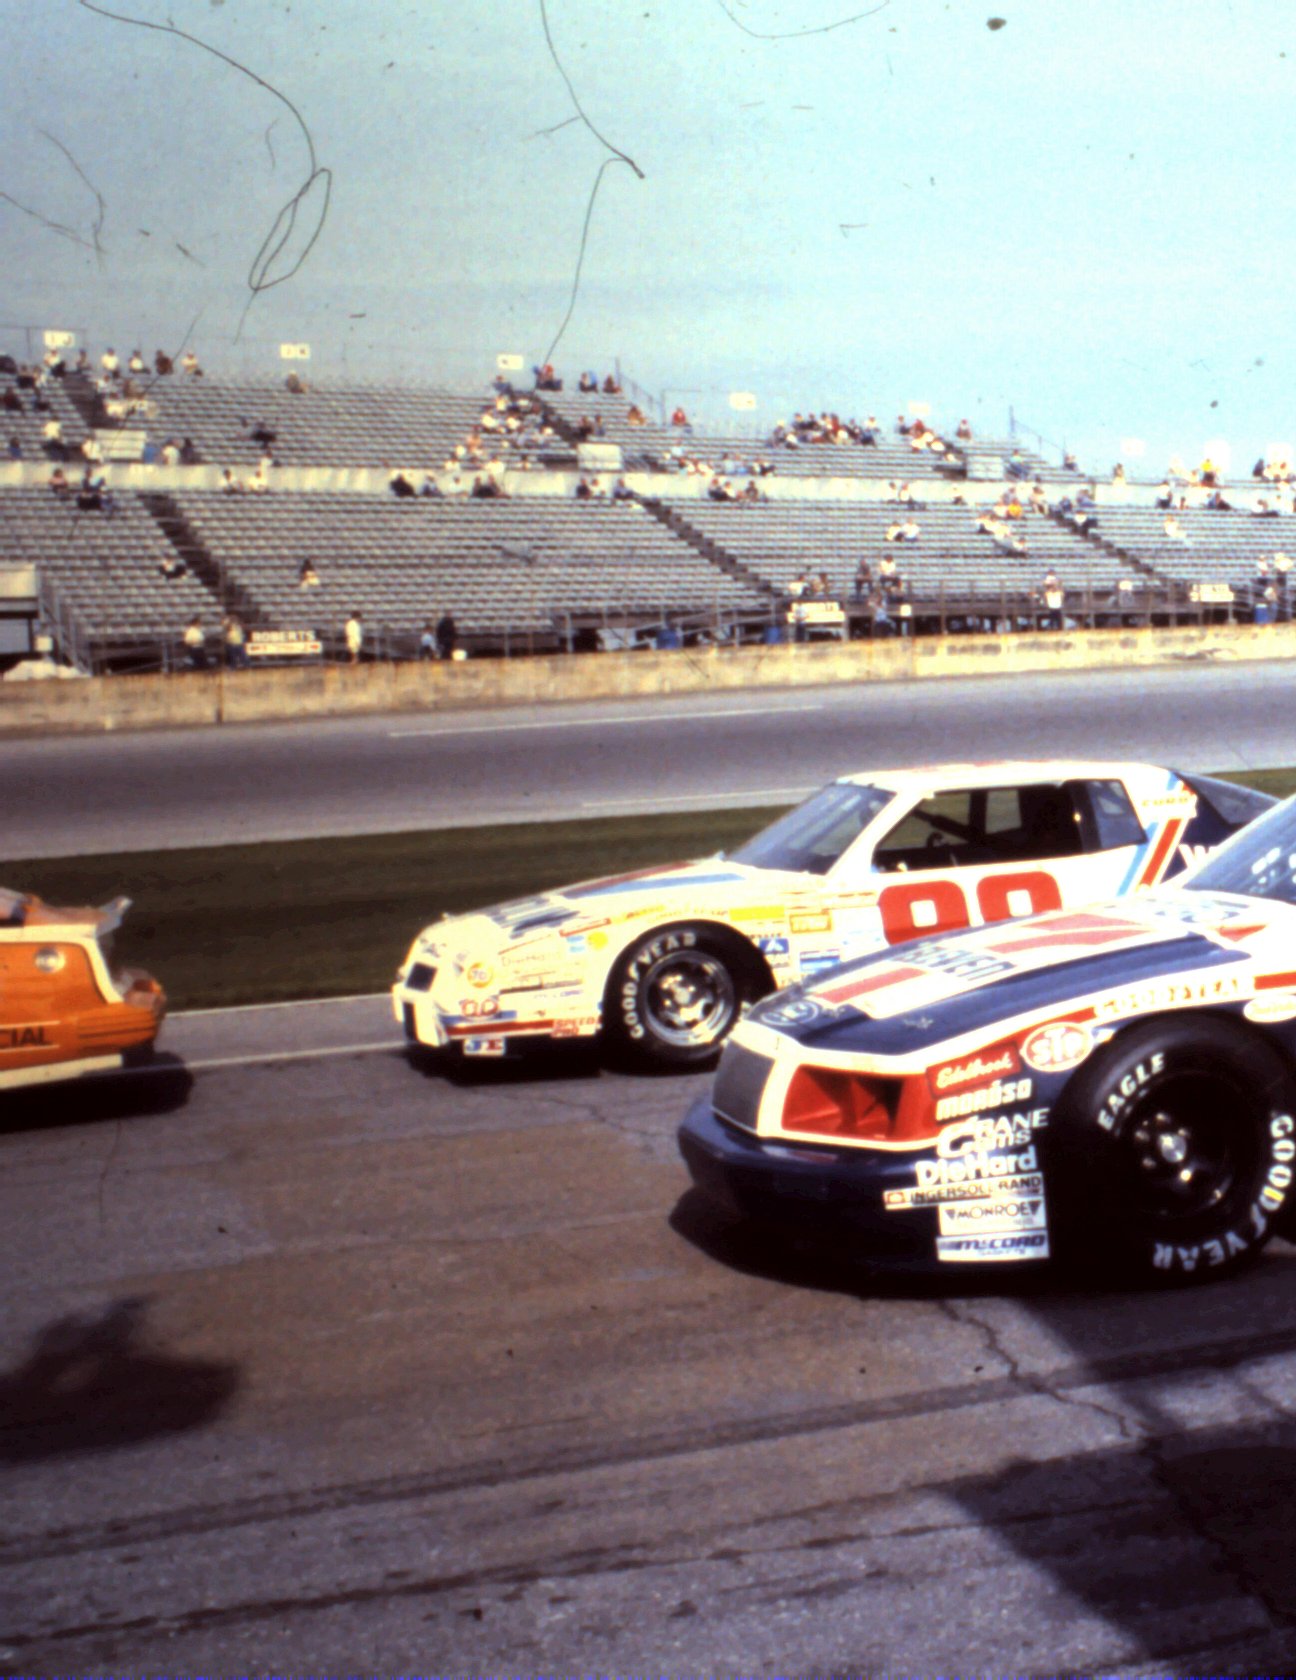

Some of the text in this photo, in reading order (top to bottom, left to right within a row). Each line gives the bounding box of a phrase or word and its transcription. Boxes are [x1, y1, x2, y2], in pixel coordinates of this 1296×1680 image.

[1030, 1027, 1084, 1066] STP
[1096, 1052, 1166, 1132] EAGLE
[957, 1201, 1031, 1220] MONROE
